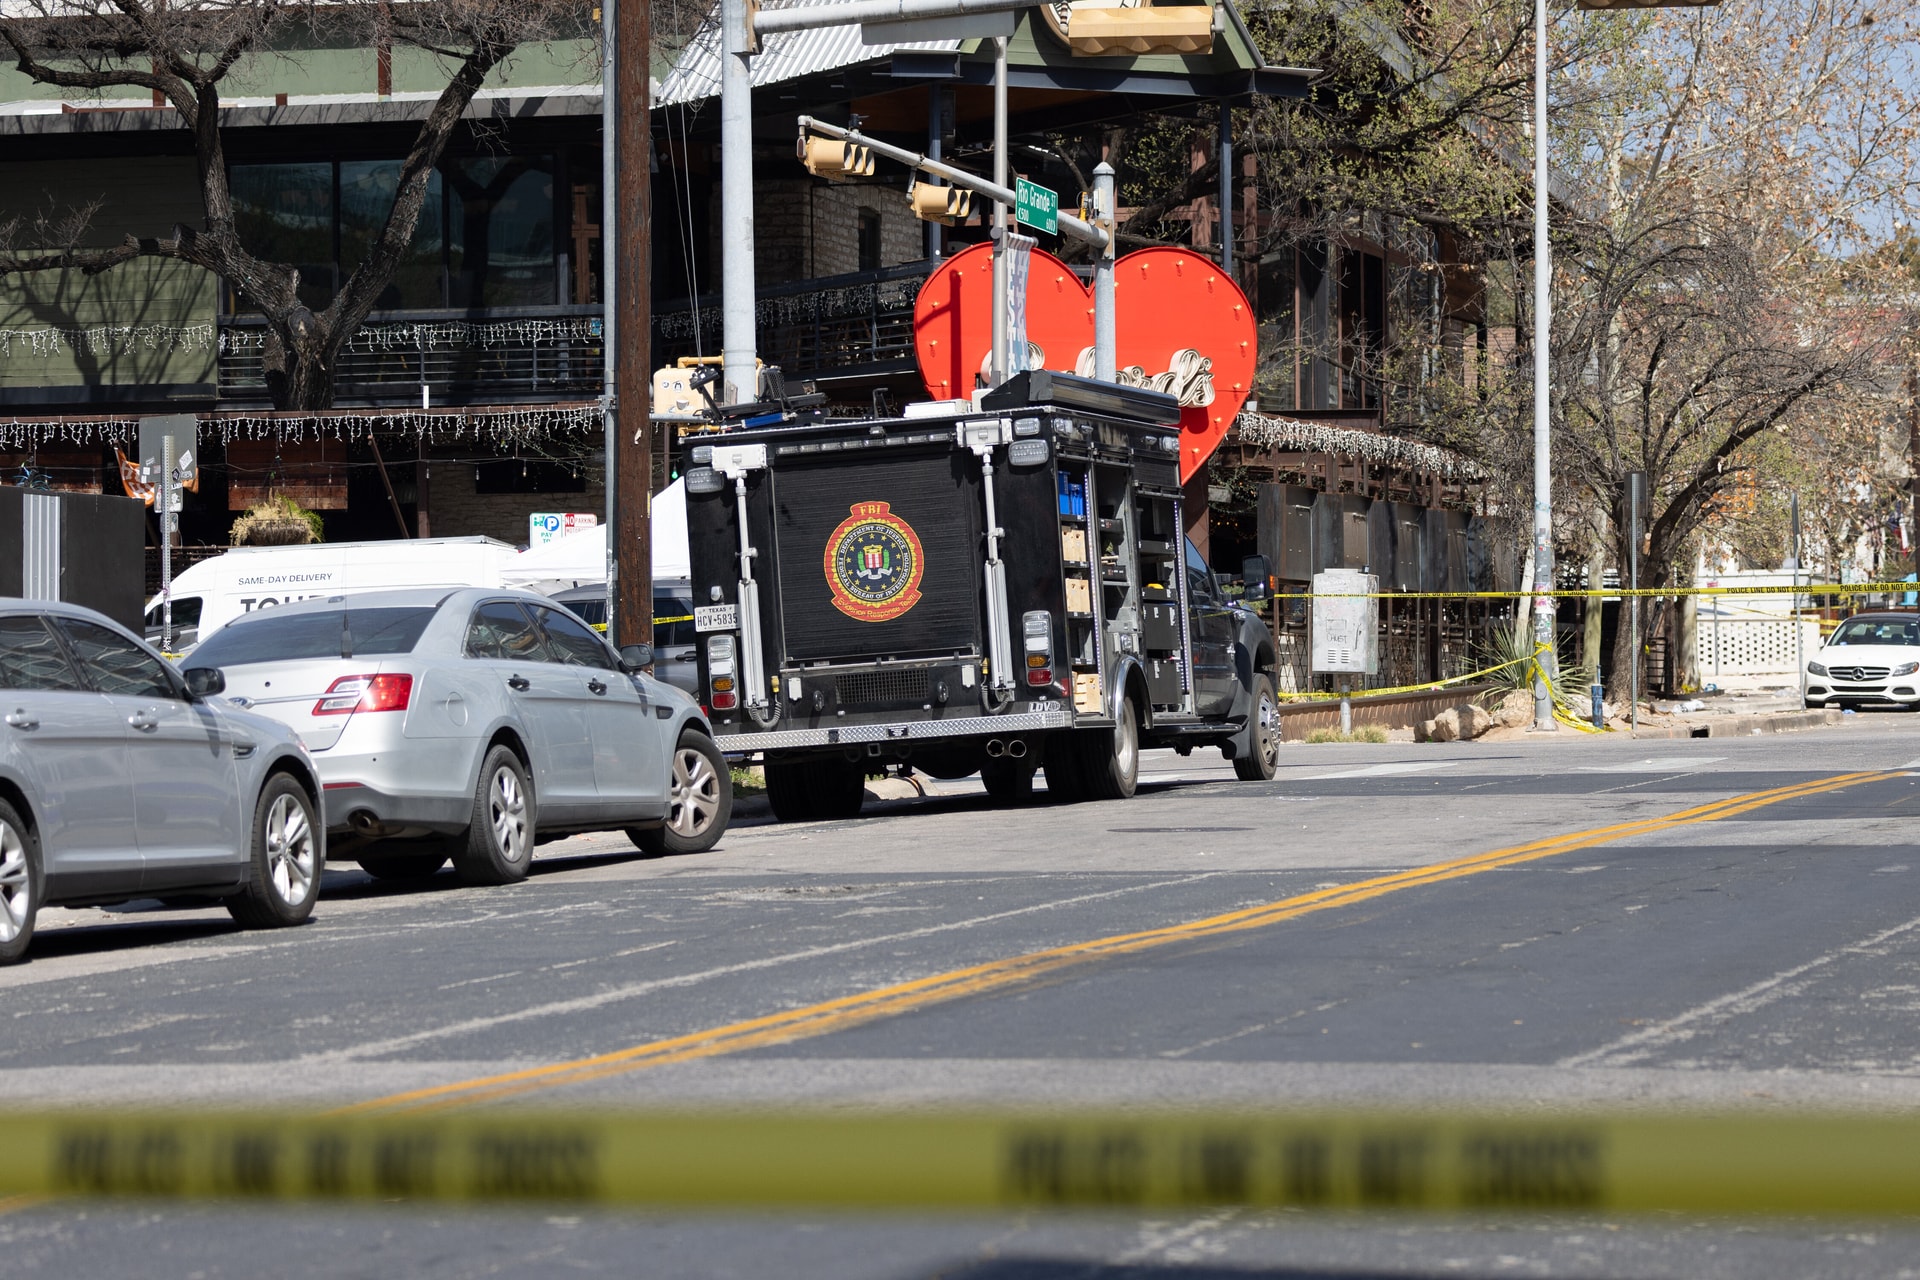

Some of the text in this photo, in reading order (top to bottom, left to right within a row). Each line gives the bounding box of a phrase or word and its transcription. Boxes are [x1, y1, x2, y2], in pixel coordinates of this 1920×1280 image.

[1018, 181, 1056, 213] Rio Grande ST
[859, 504, 881, 516] FBI
[565, 516, 575, 526] NO
[841, 525, 875, 554] DEPARTMENT
[885, 529, 906, 550] JUSTICE
[238, 572, 333, 585] SAME-DAY DELIVERY
[838, 557, 851, 588] FEDERAL
[850, 585, 874, 599] BUREAU
[885, 552, 909, 597] INVESTIGATION
[837, 593, 917, 618] Evidence Response Team
[697, 615, 713, 627] HCV
[1029, 701, 1051, 713] LDV
